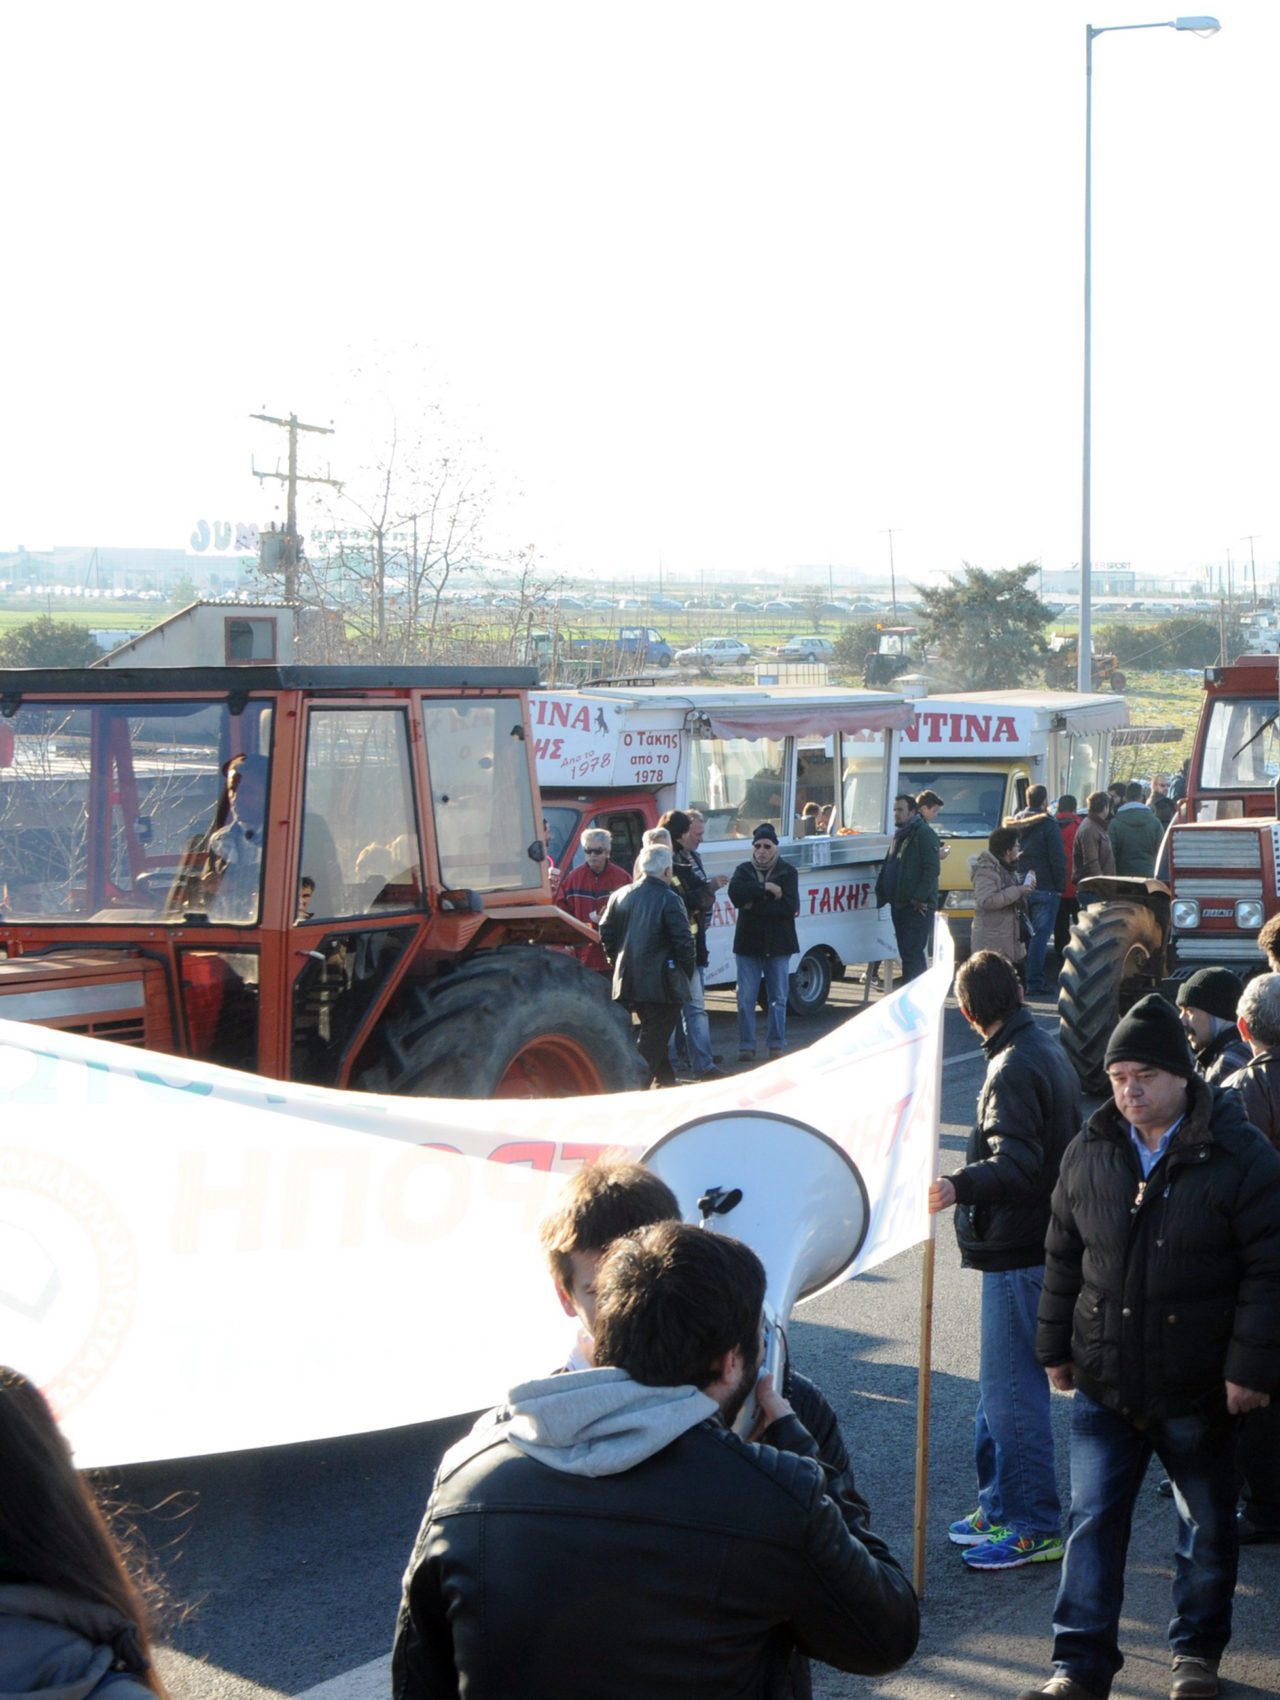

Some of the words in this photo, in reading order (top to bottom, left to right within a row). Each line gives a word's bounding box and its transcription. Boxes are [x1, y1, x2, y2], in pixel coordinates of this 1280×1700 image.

[657, 754, 670, 764] το
[570, 753, 612, 780] 1978
[634, 770, 663, 784] 1978
